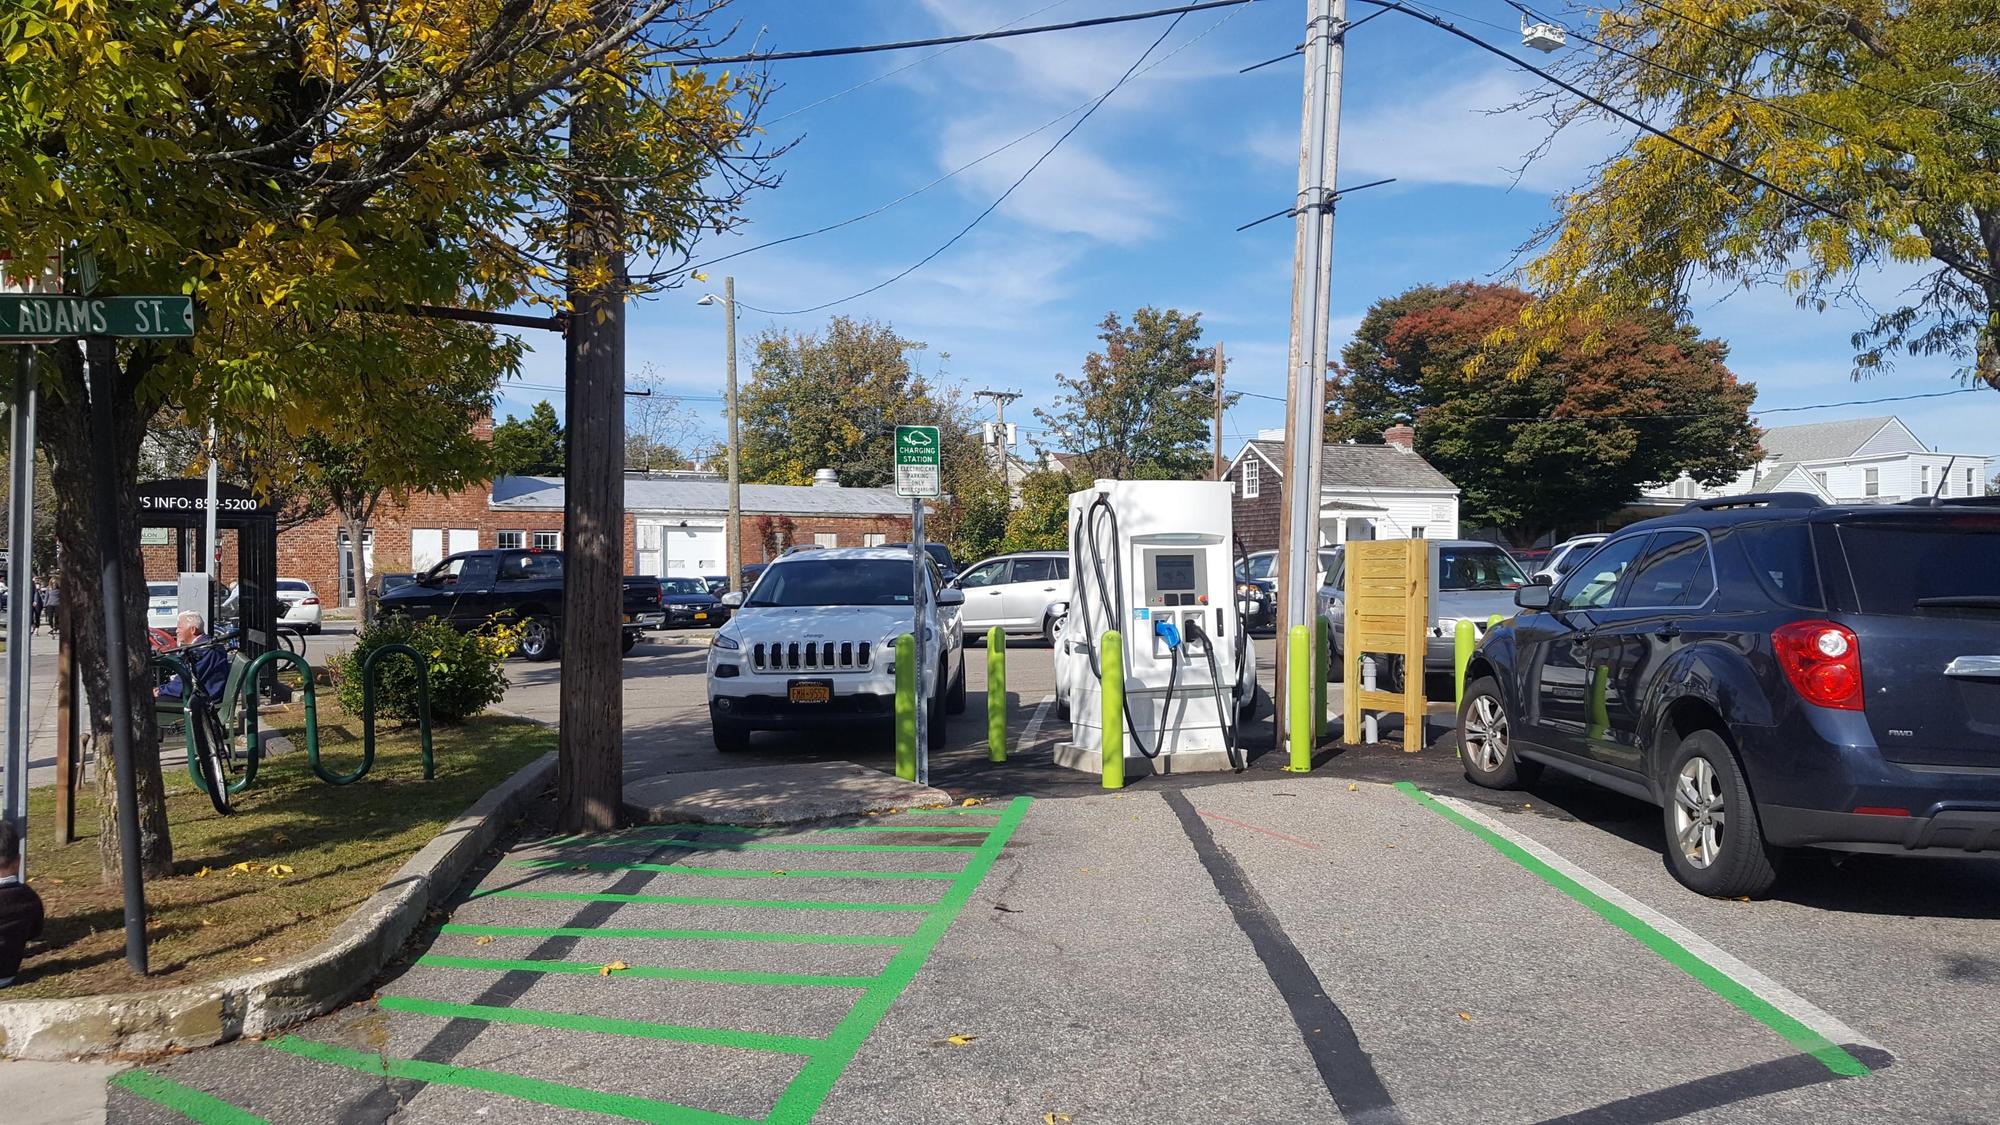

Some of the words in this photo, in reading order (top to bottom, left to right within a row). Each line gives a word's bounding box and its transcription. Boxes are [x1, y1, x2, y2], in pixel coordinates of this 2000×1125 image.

[18, 300, 107, 333] ADAMS
[134, 300, 169, 333] ST.
[899, 446, 935, 454] CHARGING
[903, 455, 933, 463] STATION
[155, 496, 192, 509] INFO:
